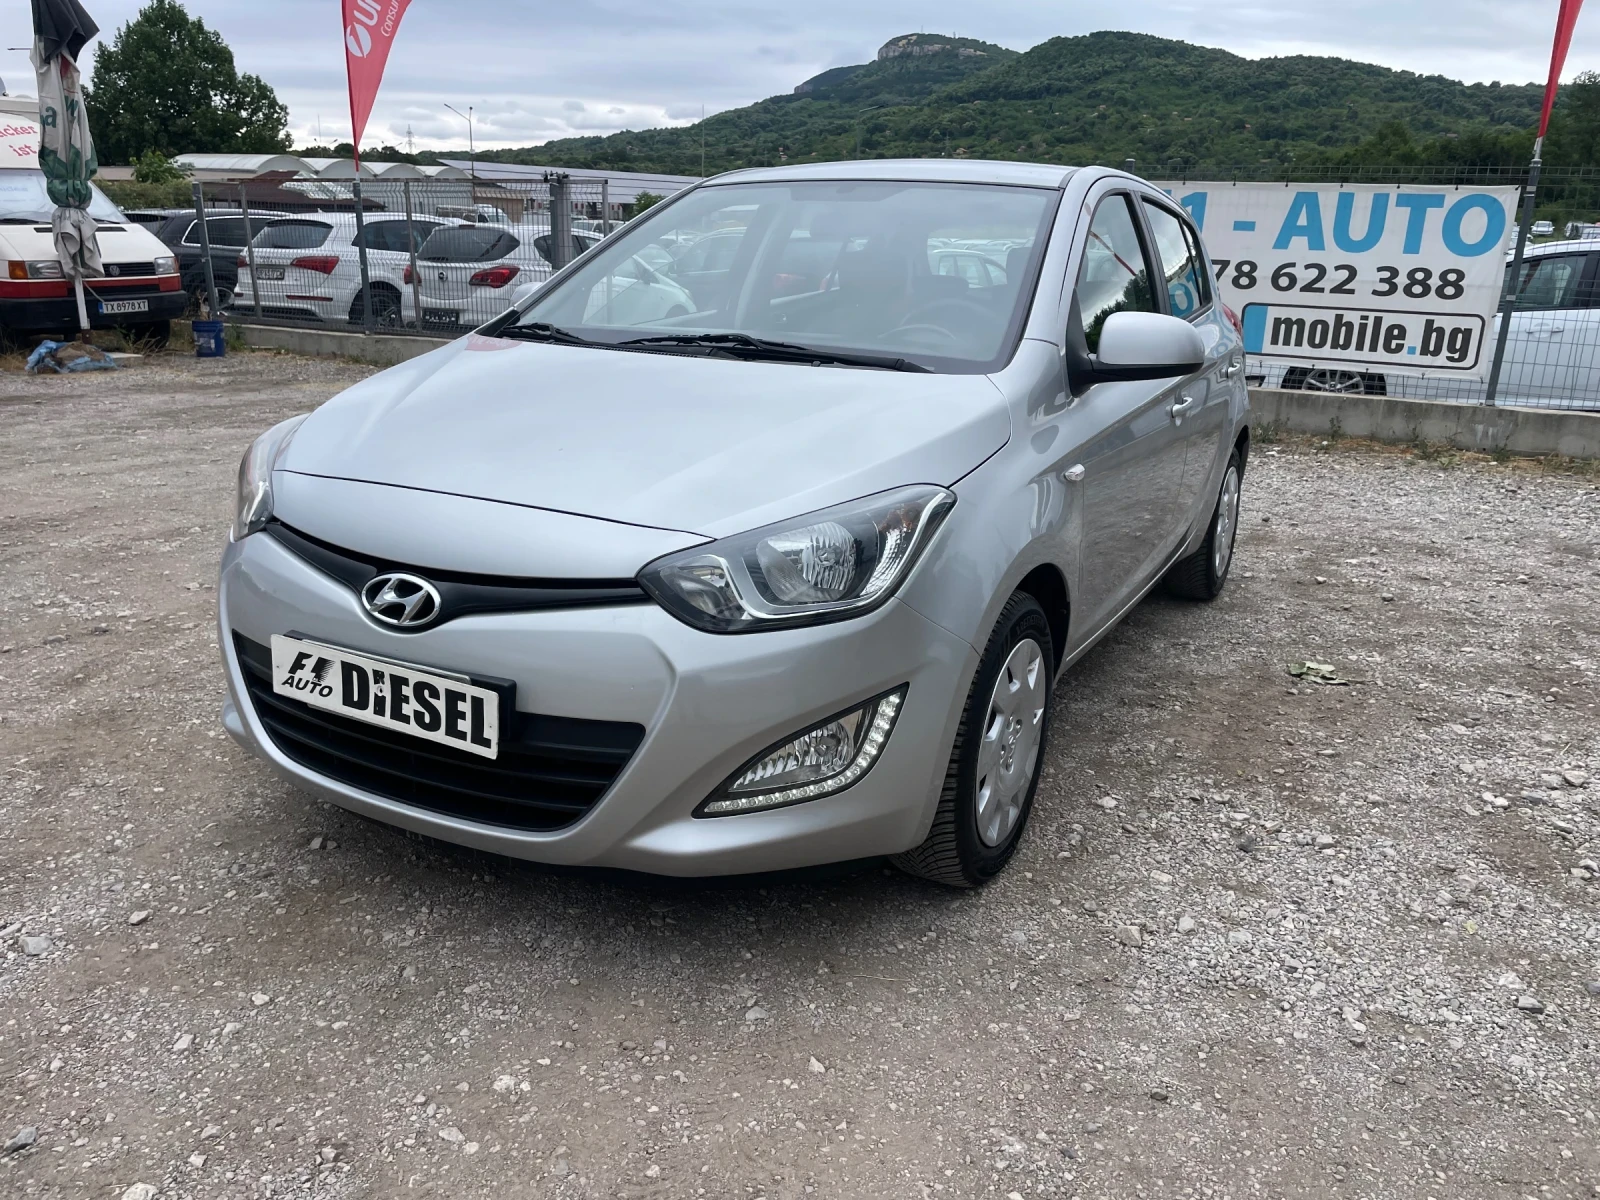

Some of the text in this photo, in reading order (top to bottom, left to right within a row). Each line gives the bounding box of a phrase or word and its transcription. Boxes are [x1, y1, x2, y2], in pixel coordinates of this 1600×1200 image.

[1272, 192, 1506, 257] AUTO
[1271, 262, 1358, 295] 622
[1371, 265, 1466, 300] 388
[1270, 313, 1473, 363] mobile.bg
[281, 675, 333, 697] AUTO
